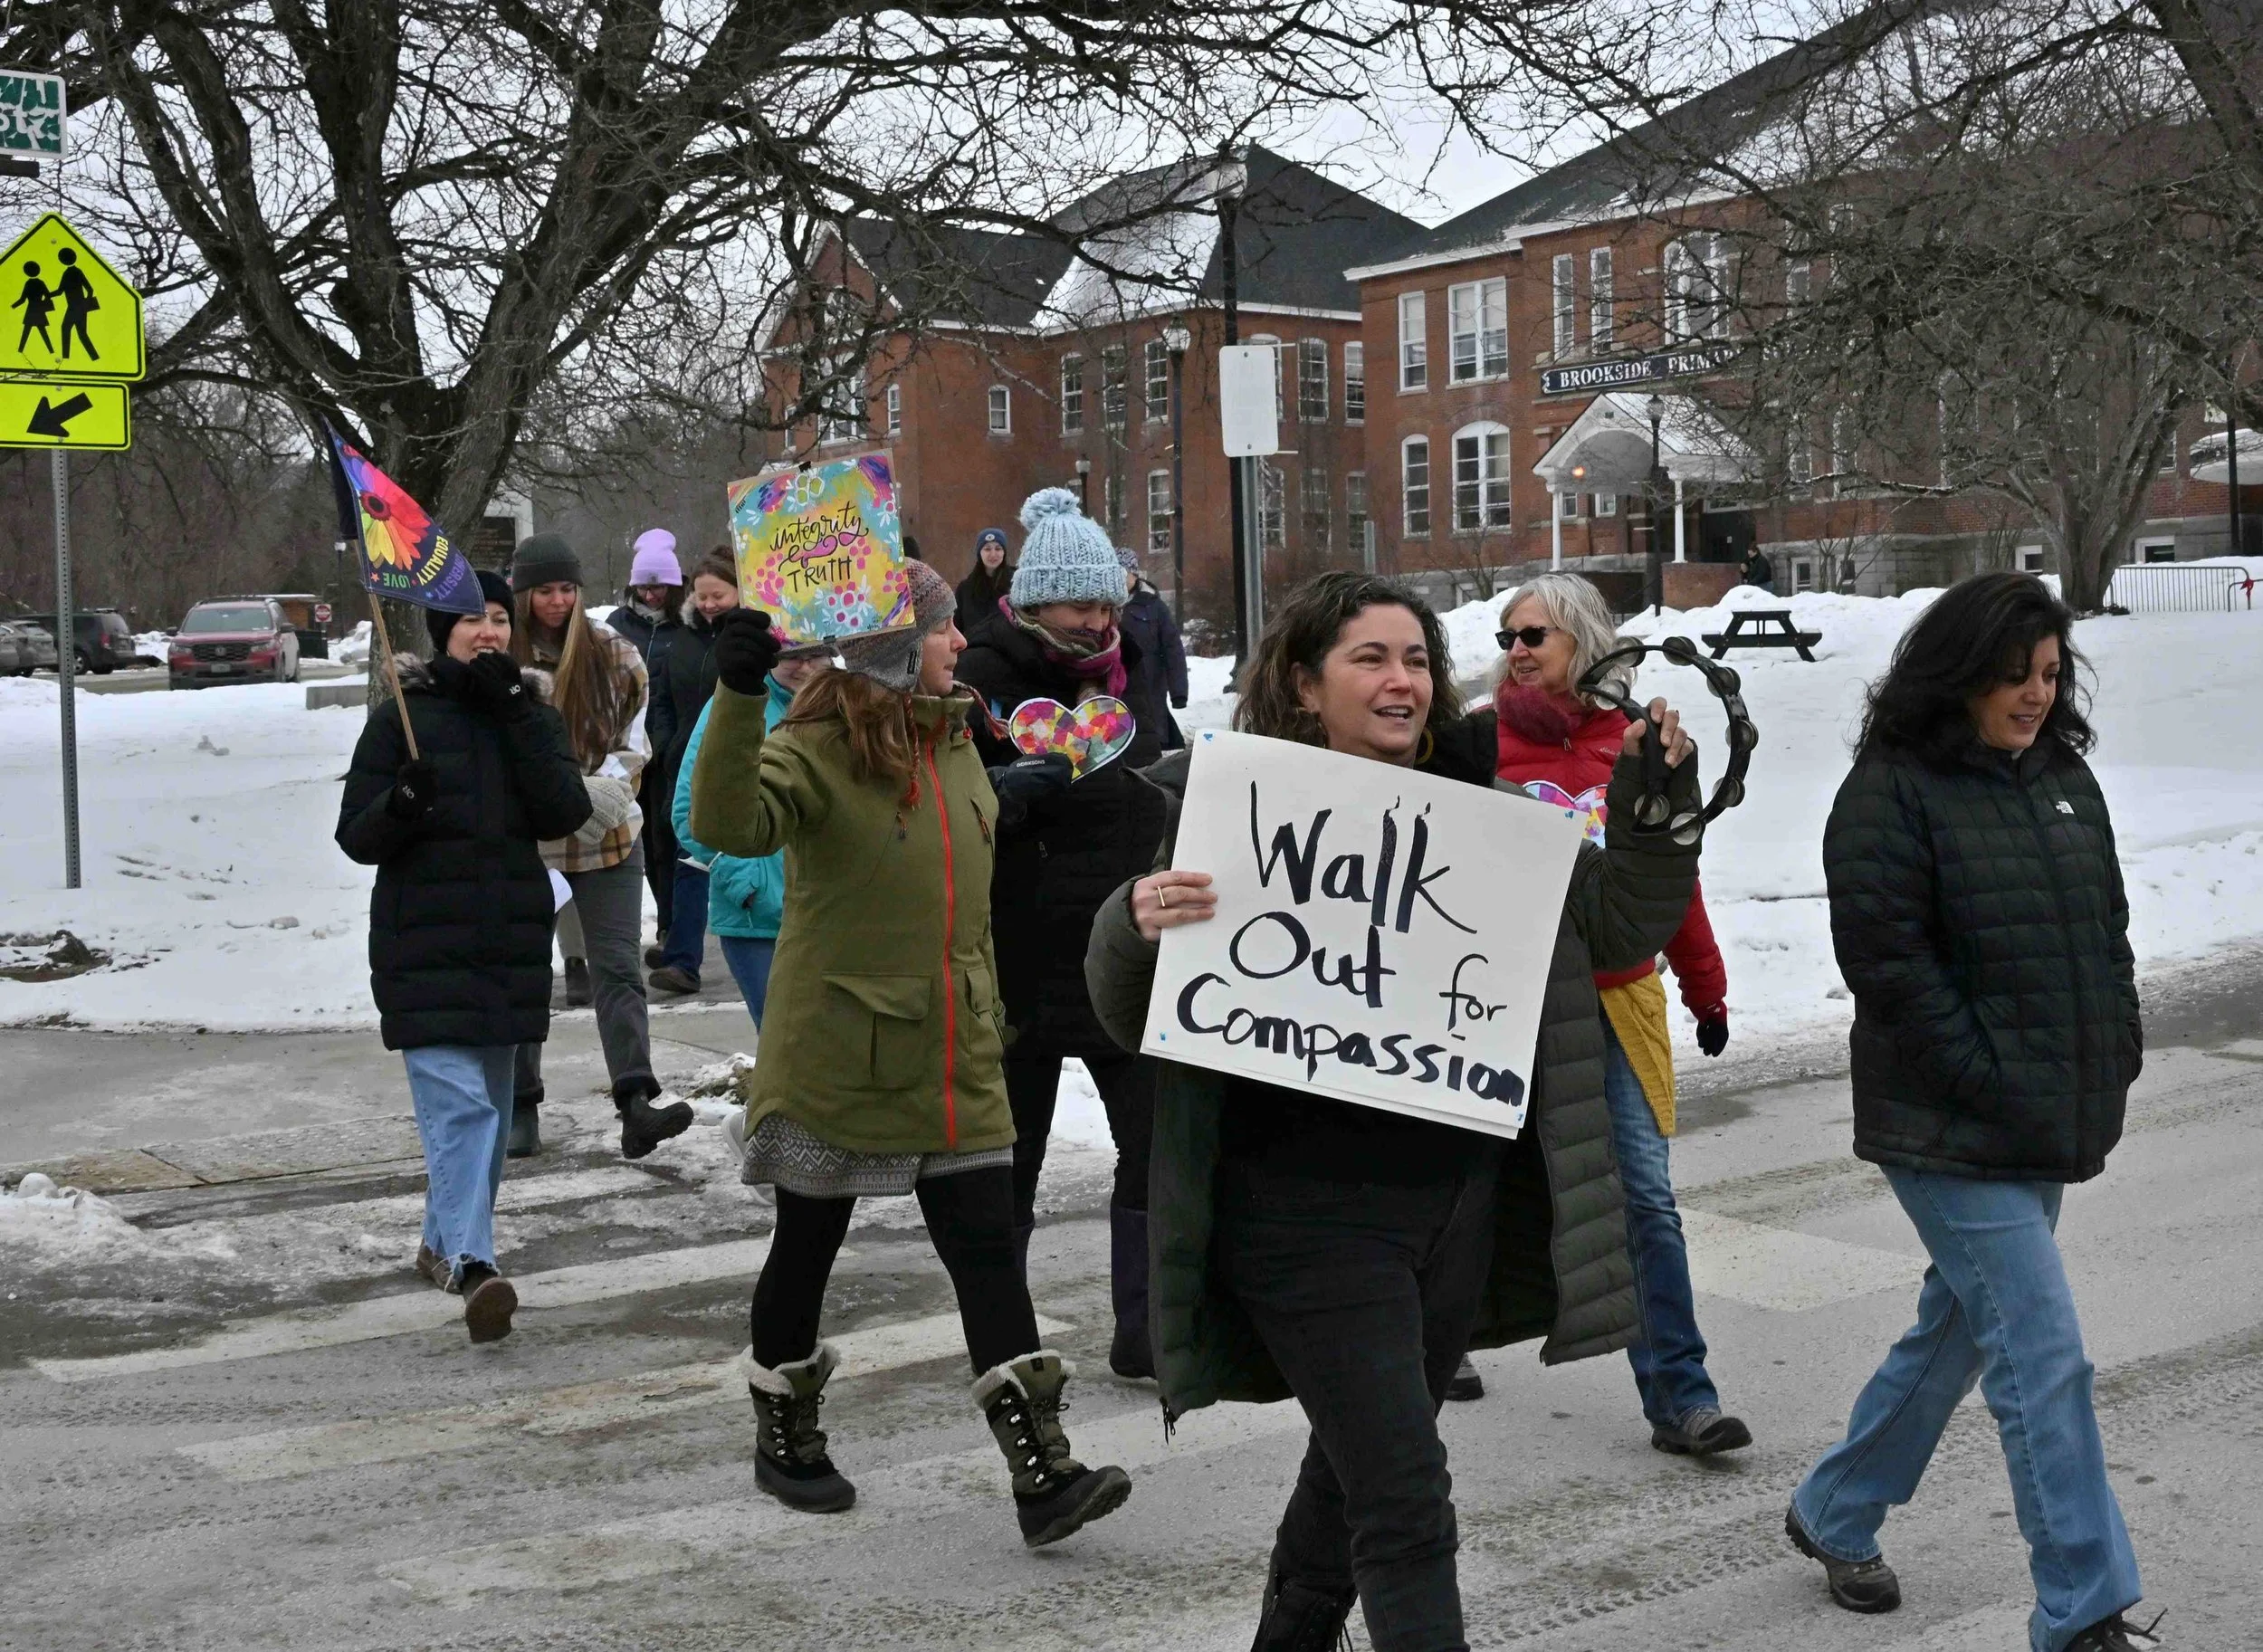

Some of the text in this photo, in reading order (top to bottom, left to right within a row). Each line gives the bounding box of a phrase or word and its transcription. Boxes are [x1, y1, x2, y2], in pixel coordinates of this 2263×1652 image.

[1560, 360, 1652, 387] BROOKSIDE
[769, 501, 869, 551] integrity
[383, 535, 449, 588] EQUALITY LOVE
[787, 556, 852, 593] TRUTH
[1250, 780, 1477, 934] Walk
[1229, 912, 1507, 1032] Out for
[1176, 973, 1525, 1107] Compassion
